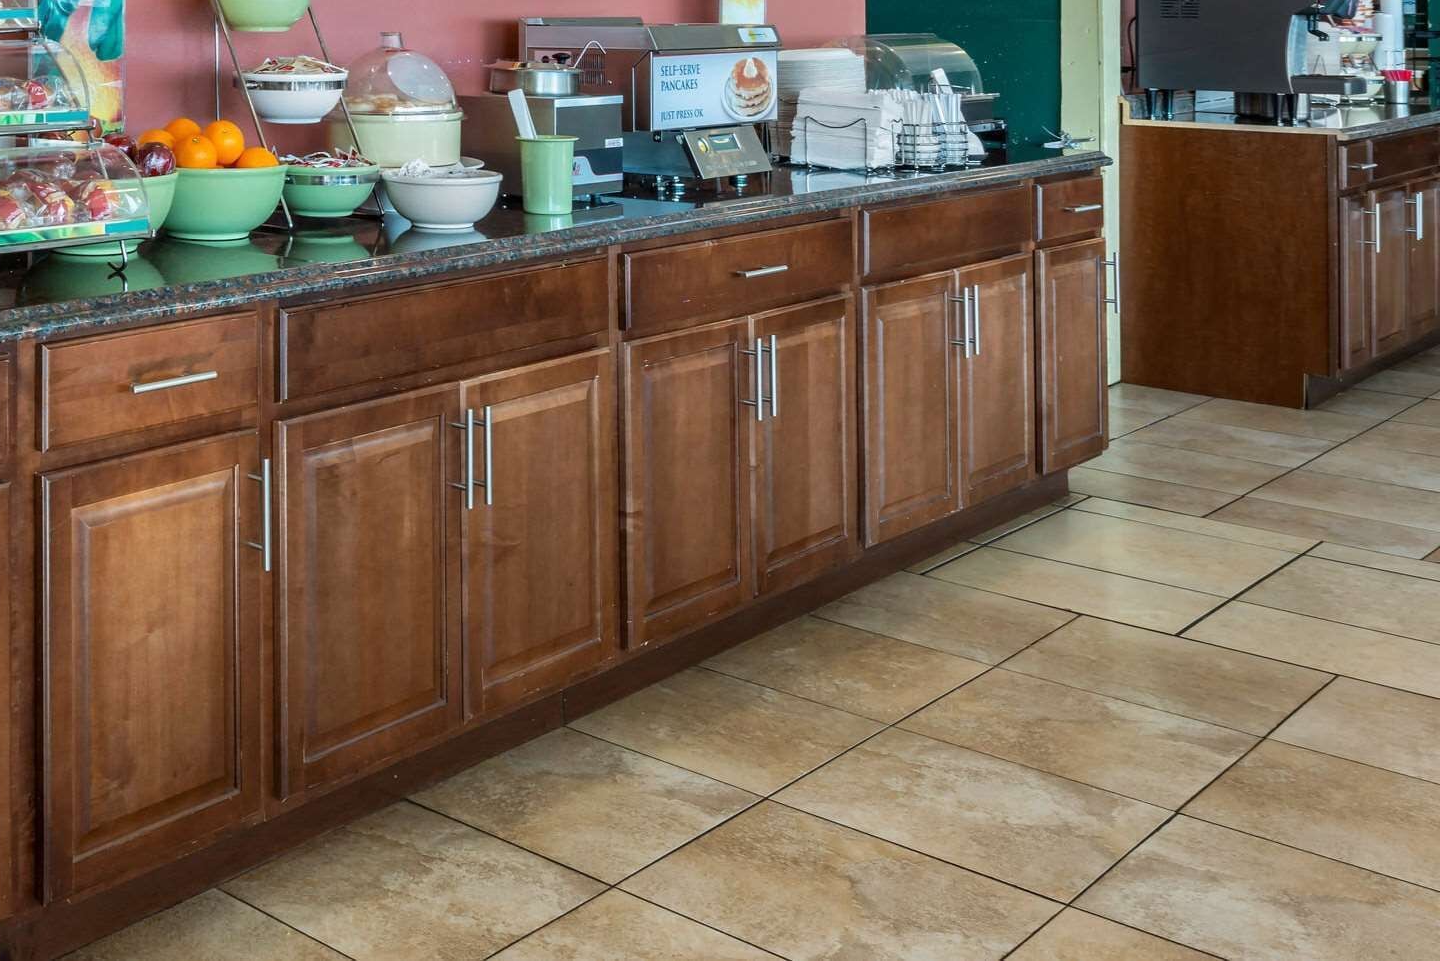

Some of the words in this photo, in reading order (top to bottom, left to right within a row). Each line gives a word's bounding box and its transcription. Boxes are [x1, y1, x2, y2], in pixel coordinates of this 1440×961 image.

[660, 64, 701, 76] SELF-SERVE
[660, 79, 698, 91] PANCAKES
[660, 110, 675, 122] JUST
[676, 109, 693, 119] PRESS
[694, 109, 704, 118] OK
